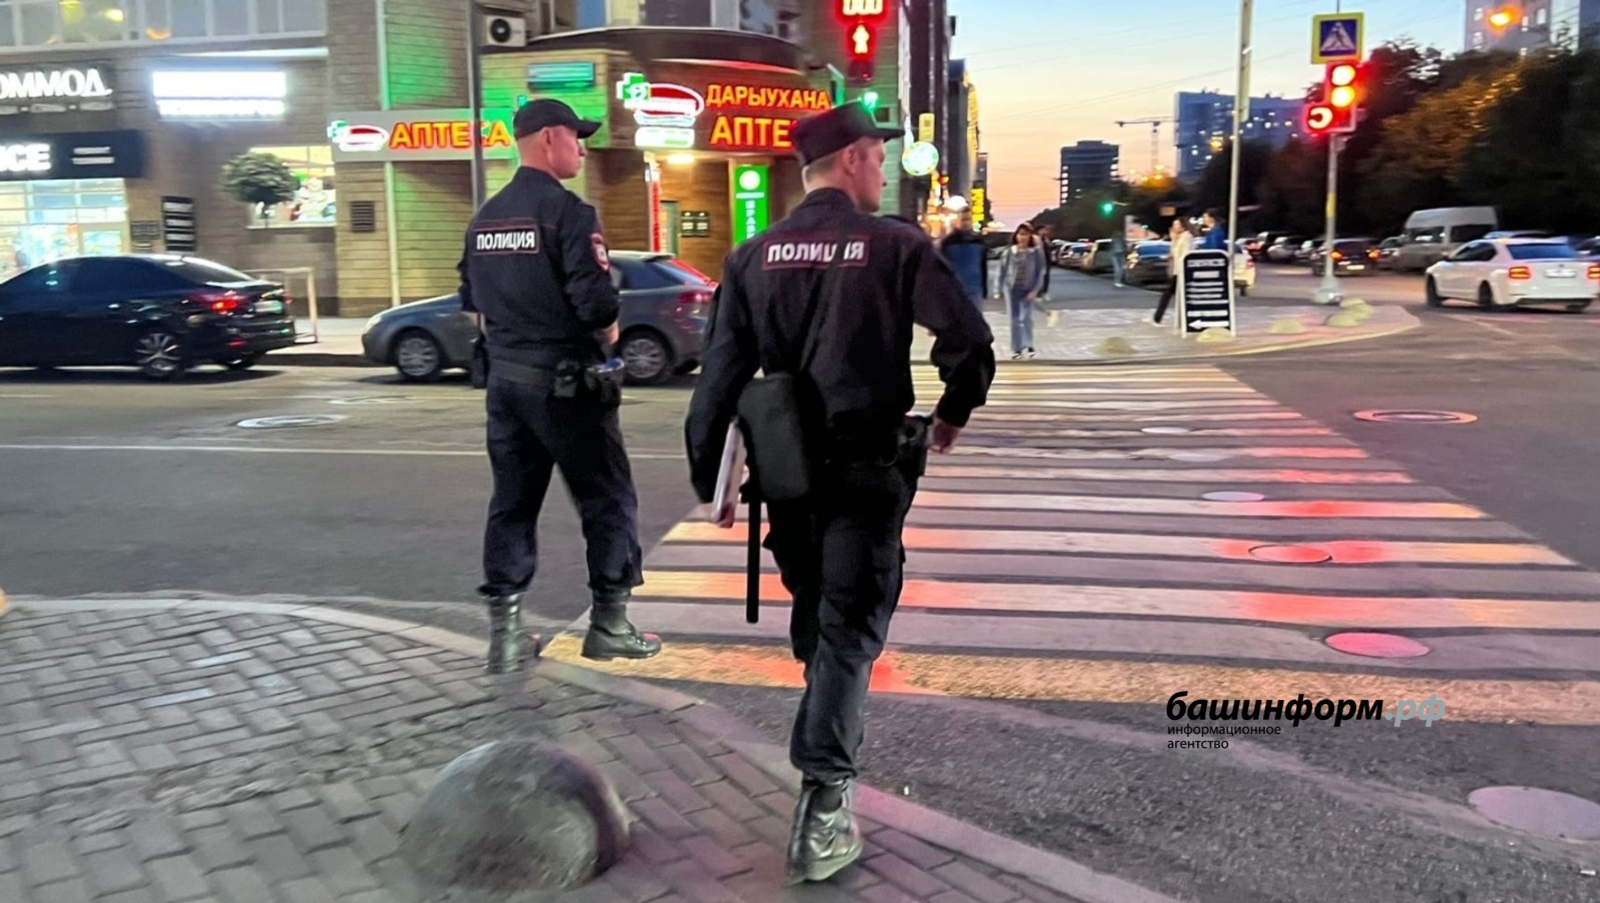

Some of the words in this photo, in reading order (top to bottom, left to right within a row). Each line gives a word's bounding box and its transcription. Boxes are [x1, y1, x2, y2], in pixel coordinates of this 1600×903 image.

[706, 84, 832, 110] ДАРЫУХАНА
[709, 116, 794, 149] АПТЕ
[476, 231, 536, 251] ПОЛИЦИЯ
